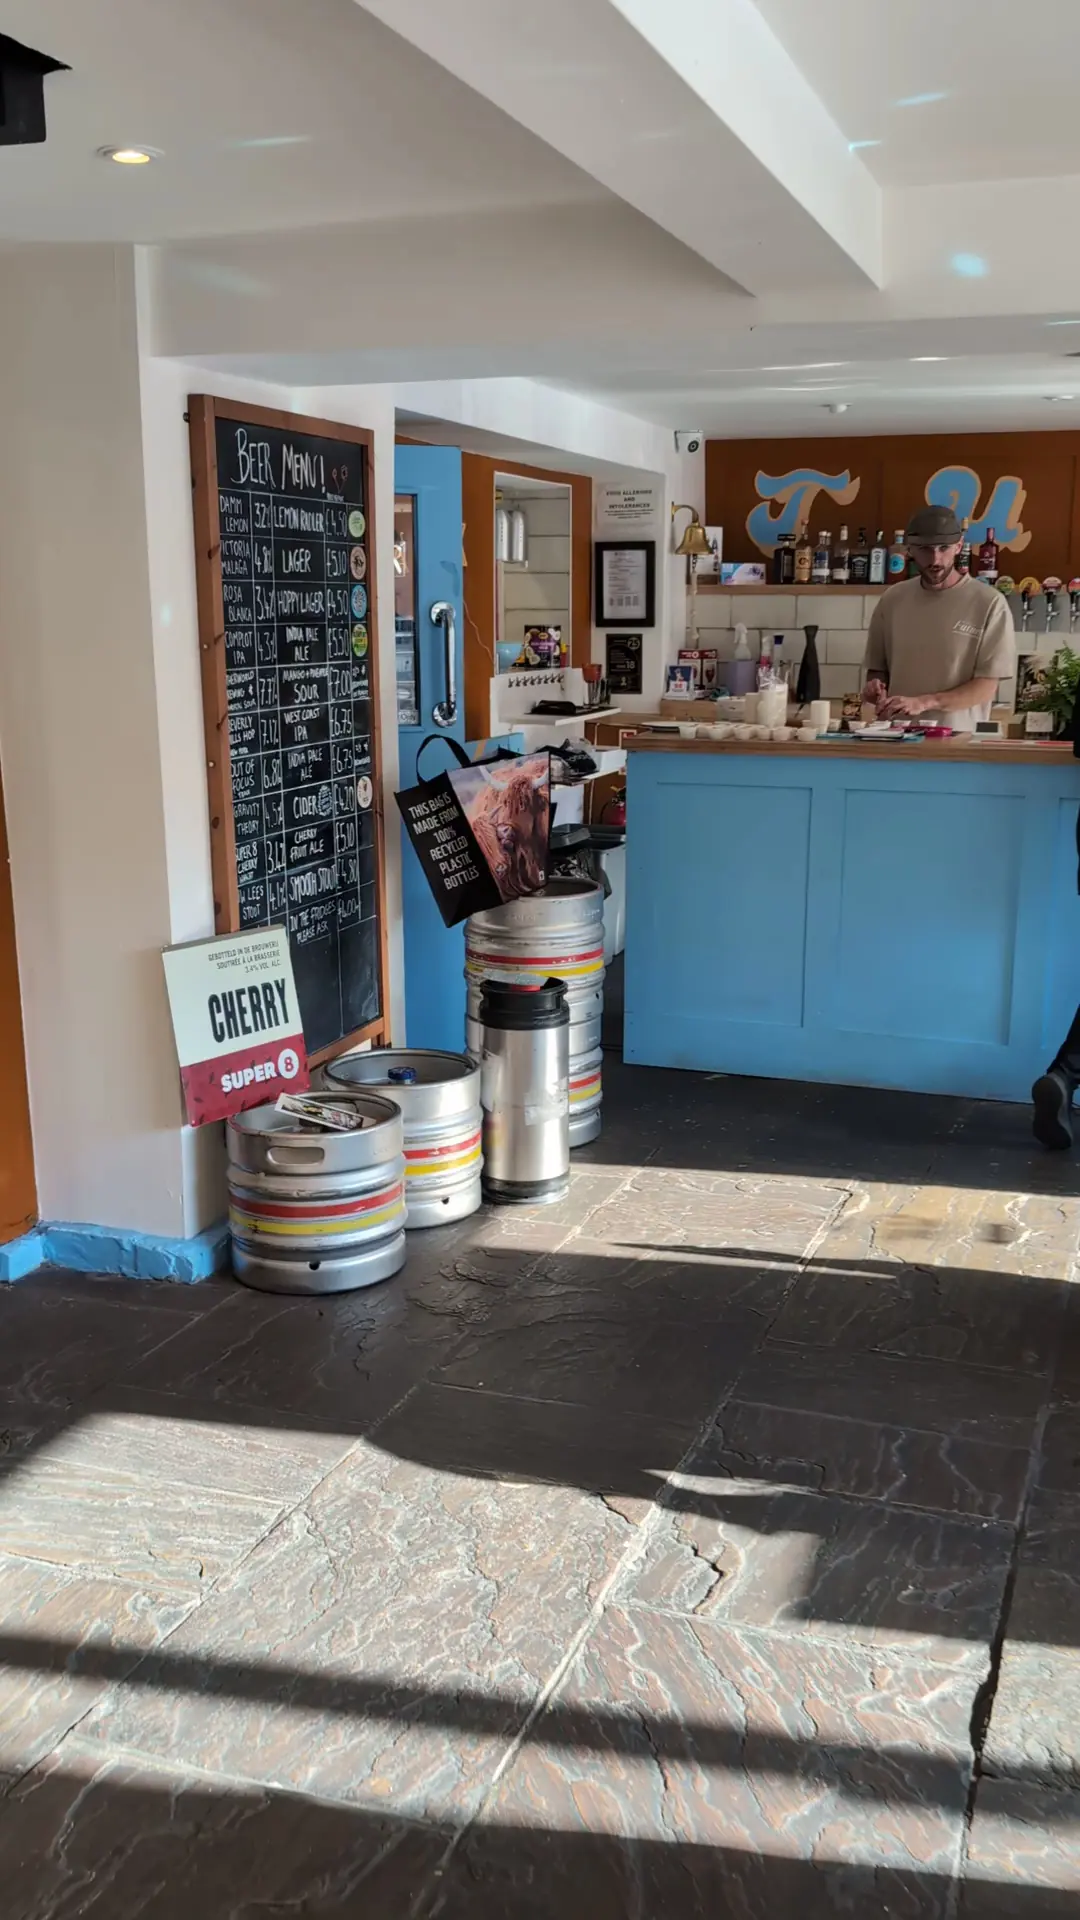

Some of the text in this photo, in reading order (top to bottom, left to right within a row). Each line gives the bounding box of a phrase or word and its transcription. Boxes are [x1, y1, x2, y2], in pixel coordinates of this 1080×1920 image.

[231, 428, 325, 493] BEER MENU!
[220, 496, 243, 514] DAMM
[226, 516, 248, 533] LEMON
[274, 505, 300, 530] LEMON
[222, 539, 250, 558] ICTORIA
[282, 548, 311, 574] LAGER
[224, 584, 243, 603] ROSA
[277, 590, 300, 617] HOPPY
[228, 605, 252, 622] BLANCA
[225, 630, 252, 649] COMPLOT
[234, 650, 245, 665] IPA
[294, 645, 309, 661] ALE
[294, 684, 319, 704] SOUR
[284, 708, 320, 724] WEST COAST
[330, 708, 352, 737] £6.75
[294, 726, 308, 742] IPA
[246, 758, 255, 774] OF
[288, 748, 322, 769] INDIA PALE
[300, 765, 313, 781] ALE
[232, 775, 255, 794] FOCUS
[293, 796, 317, 819] CIDER
[408, 792, 451, 819] THIS BAG IS
[237, 820, 259, 836] THEORY
[413, 804, 459, 835] MADE FROM
[433, 826, 457, 844] 100%
[253, 842, 258, 856] 8
[290, 839, 324, 862] FRUIT ALE
[430, 836, 468, 861] RECYCLED
[439, 852, 473, 875] PLASTIC
[289, 865, 337, 903] SMOOTH STOUT
[444, 866, 480, 890] BOTTLES
[248, 886, 263, 901] LEES
[242, 904, 260, 920] STOUT
[290, 900, 336, 932] IN THE FRIDGES
[296, 921, 328, 943] PLEASE ASK
[244, 946, 250, 954] DE
[254, 950, 280, 962] BRASSERIE
[208, 978, 289, 1043] CHERRY
[221, 1061, 277, 1093] SUPER
